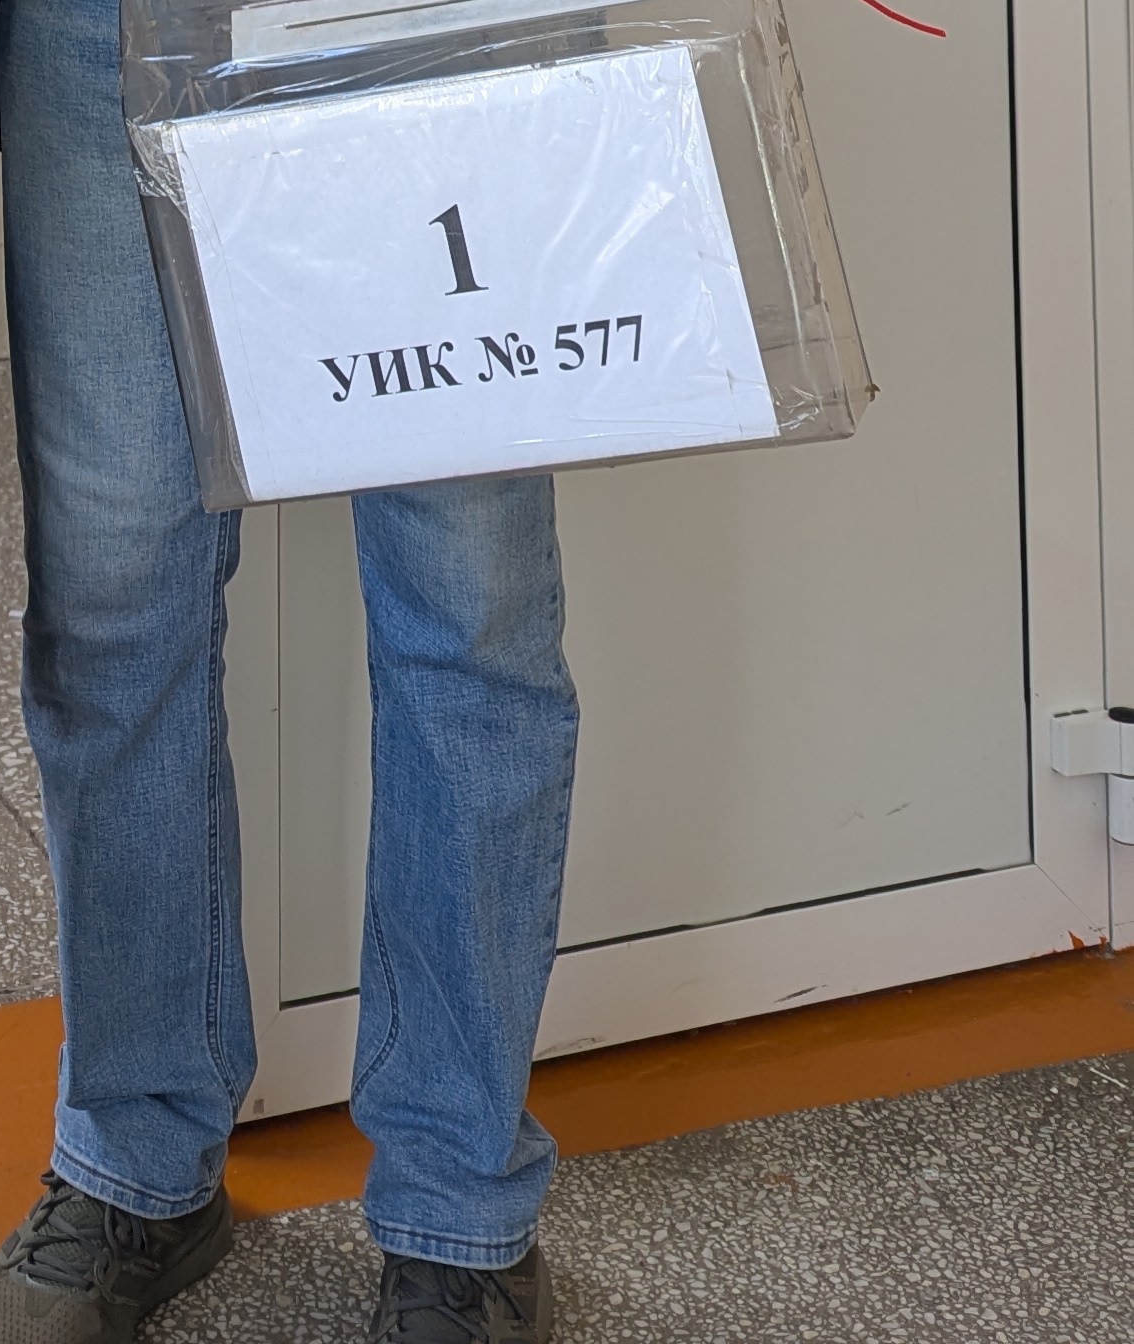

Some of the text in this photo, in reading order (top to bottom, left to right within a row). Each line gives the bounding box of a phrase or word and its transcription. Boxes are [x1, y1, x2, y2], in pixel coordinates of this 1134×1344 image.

[427, 202, 489, 297] 1
[318, 314, 644, 403] УИК № 577
